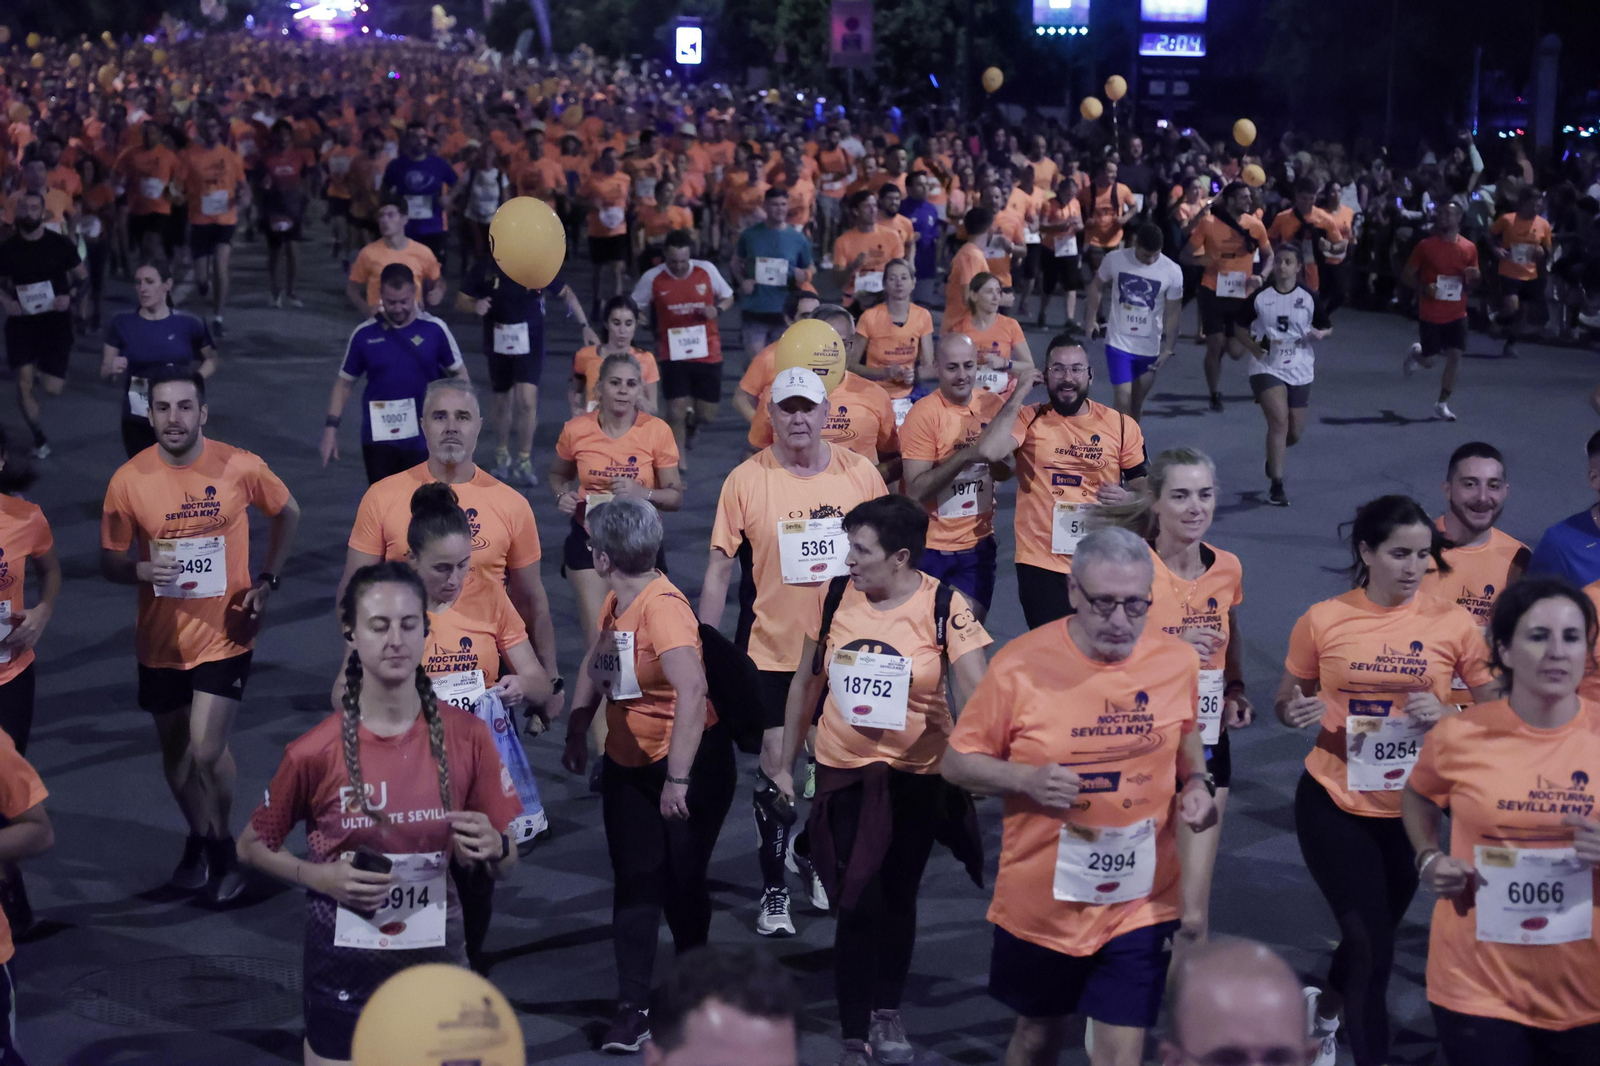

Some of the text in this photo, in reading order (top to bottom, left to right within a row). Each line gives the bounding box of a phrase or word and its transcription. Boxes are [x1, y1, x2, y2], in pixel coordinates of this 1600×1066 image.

[1277, 316, 1289, 333] 5
[1054, 447, 1102, 460] SEVILLA KH7
[1069, 444, 1104, 453] NOCTURNA
[951, 479, 984, 496] 19772
[181, 501, 221, 510] NOCTURNA
[165, 508, 220, 521] SEVILLA KH7
[801, 539, 835, 557] 5361
[177, 558, 212, 574] 5492
[1181, 614, 1222, 624] NOCTURNA
[428, 654, 478, 663] NOCTURNA
[594, 653, 621, 672] 21681
[1375, 655, 1428, 667] NOCTURNA
[423, 662, 478, 673] ILLA KH7
[1349, 662, 1427, 677] SEVILLA KH7
[843, 675, 892, 698] 18752
[1200, 695, 1218, 714] 36
[1097, 713, 1154, 724] NOCTURNA
[1070, 723, 1153, 738] SEVILLA KH7
[1374, 740, 1418, 761] 8254
[1528, 790, 1595, 803] NOCTURNA
[1496, 799, 1594, 816] SEVILLA KH7
[1088, 850, 1136, 872] 2994
[1508, 881, 1564, 904] 6066
